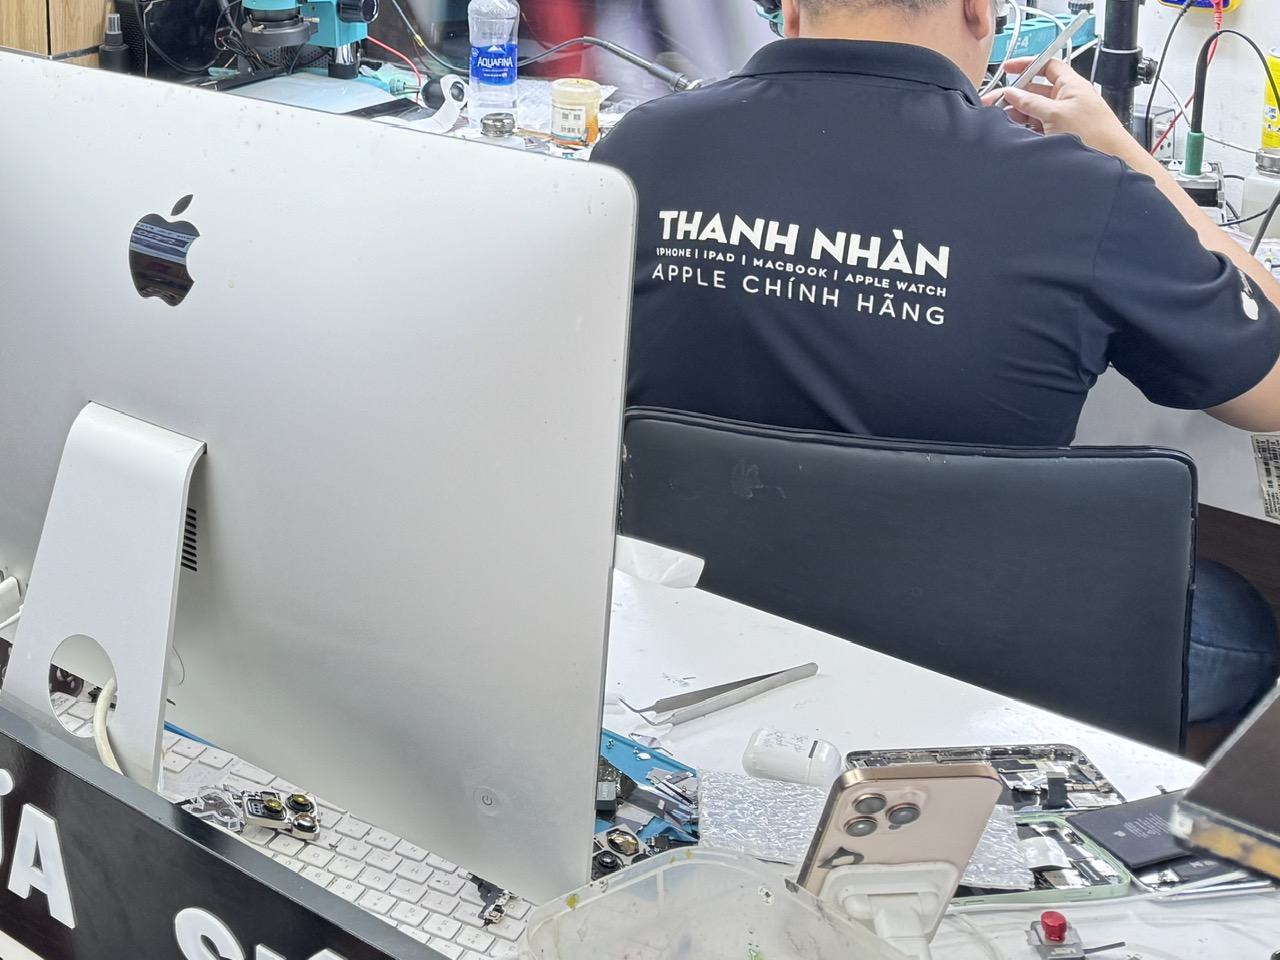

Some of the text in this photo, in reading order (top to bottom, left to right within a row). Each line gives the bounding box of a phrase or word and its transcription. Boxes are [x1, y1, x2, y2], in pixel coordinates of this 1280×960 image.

[477, 56, 513, 68] AQUAFINA
[656, 247, 692, 258] IPHONE
[703, 250, 735, 262] IPAD
[753, 258, 827, 278] MACBOOK
[844, 273, 890, 288] APPLE
[896, 280, 947, 297] WATCH
[659, 210, 950, 279] THANH NHÀN
[652, 263, 945, 325] APPLE CHÍNH HÃNG
